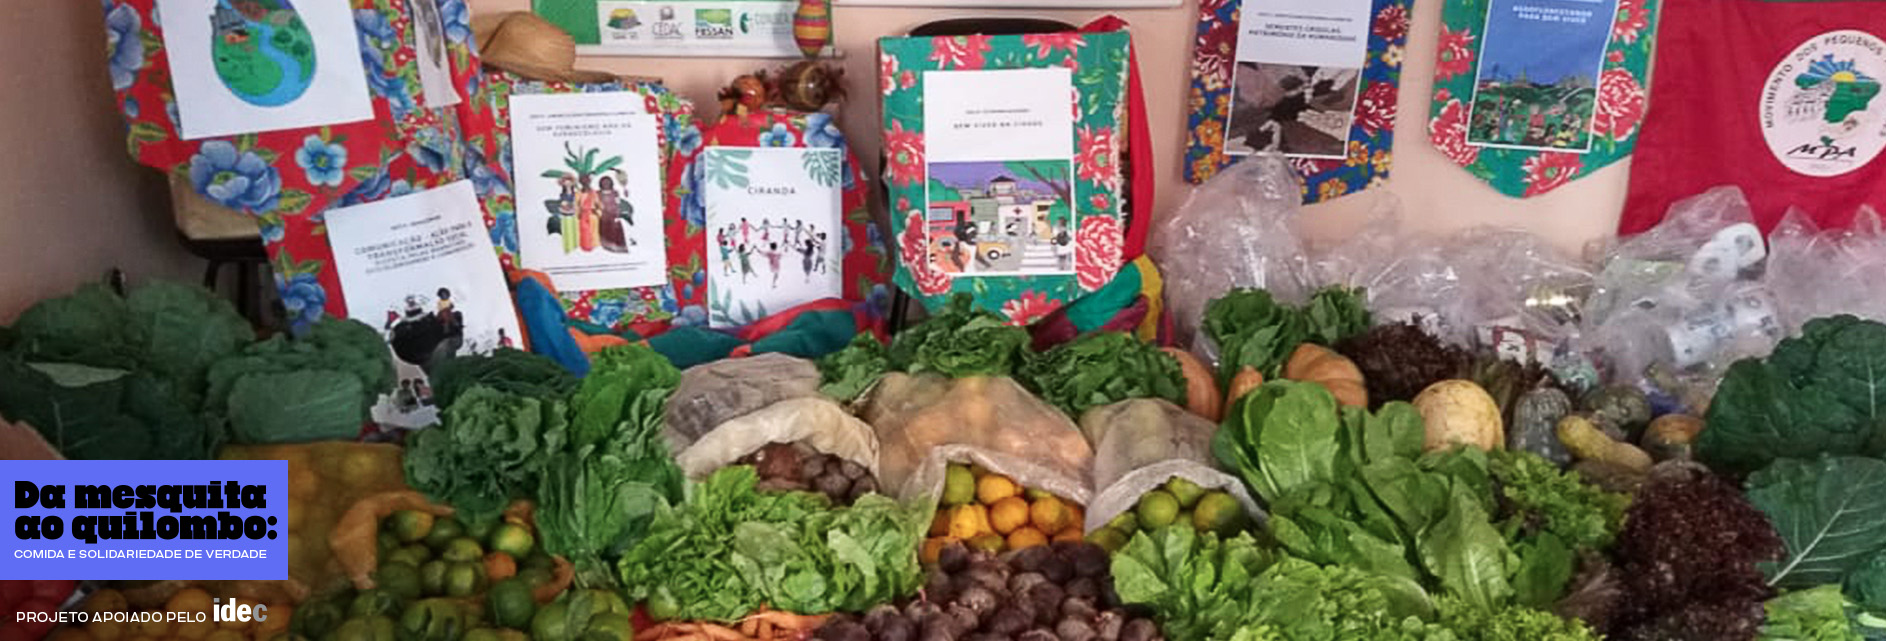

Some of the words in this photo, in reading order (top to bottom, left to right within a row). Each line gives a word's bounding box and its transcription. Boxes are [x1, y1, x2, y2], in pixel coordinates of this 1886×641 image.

[1764, 63, 1793, 128] MOVIMENTO
[1824, 35, 1883, 56] PEQUENOS
[1786, 143, 1857, 159] MPA
[747, 186, 796, 195] CIRANDA
